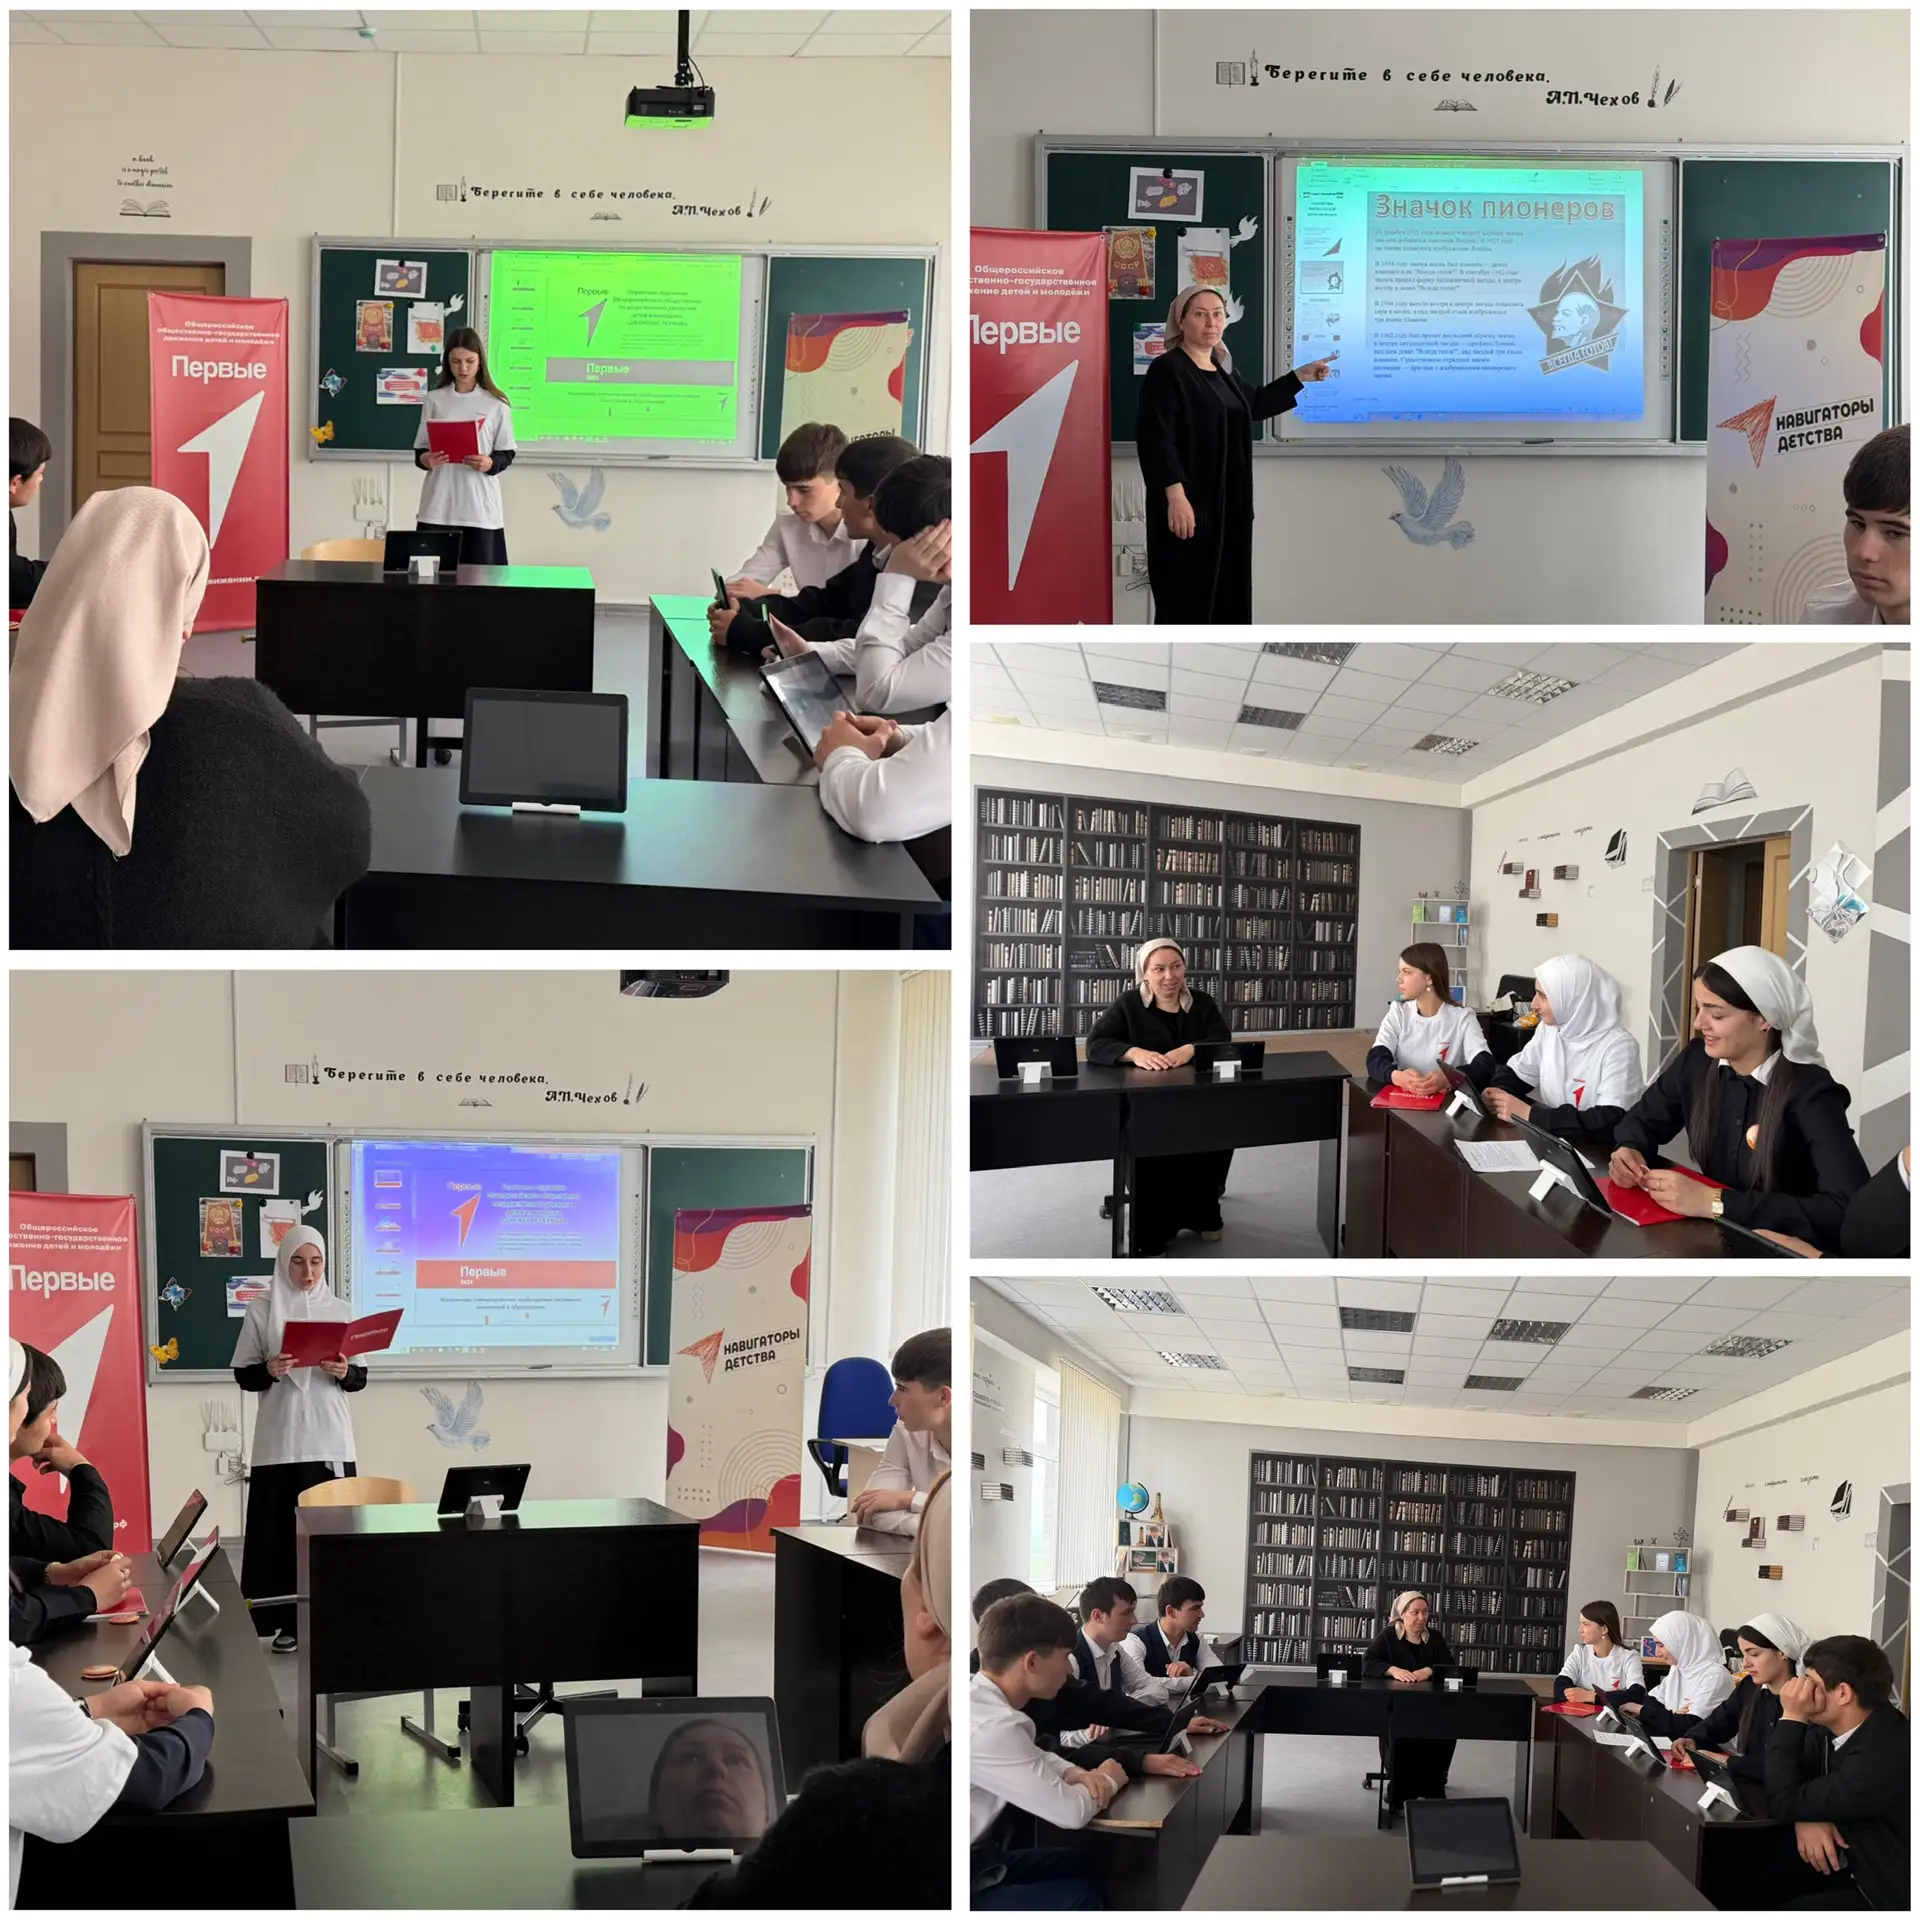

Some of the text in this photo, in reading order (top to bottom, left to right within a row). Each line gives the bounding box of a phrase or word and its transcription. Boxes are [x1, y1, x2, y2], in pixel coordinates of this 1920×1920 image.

[1264, 64, 1550, 84] Берегите в себе человека.
[470, 186, 676, 200] Берегите в себе человека.
[1376, 194, 1615, 224] Значок пионеров
[975, 265, 1064, 275] Общероссийское
[1114, 261, 1140, 270] СССР
[1040, 288, 1090, 296] молодёжи
[185, 320, 254, 330] Общероссийское
[172, 355, 267, 385] Первые
[586, 362, 630, 375] Первые
[1776, 398, 1874, 431] НАВИГАТОРЫ
[1778, 426, 1843, 453] ДЕТСТВА
[324, 1067, 549, 1084] Берегите в себе человека.
[20, 1223, 98, 1233] Общероссийское
[460, 1266, 507, 1279] Первые
[9, 1264, 115, 1299] Первые
[724, 1328, 800, 1355] НАВИГАТОРЫ
[725, 1350, 776, 1372] ДЕТСТВА
